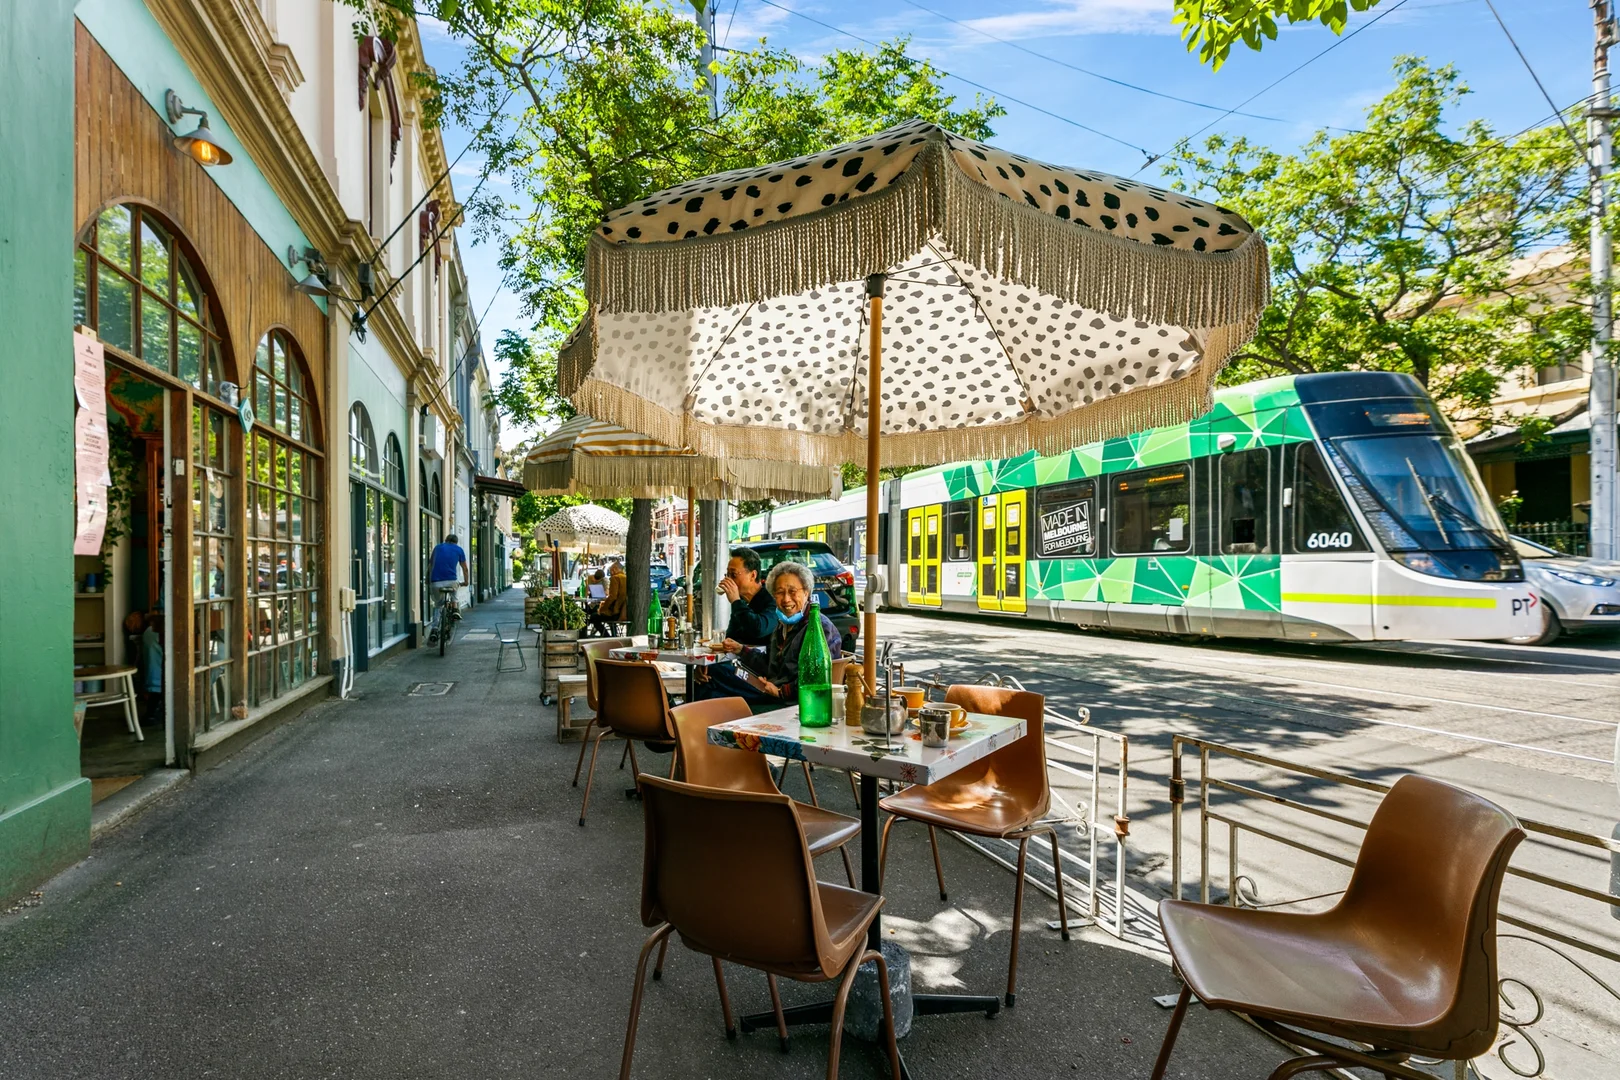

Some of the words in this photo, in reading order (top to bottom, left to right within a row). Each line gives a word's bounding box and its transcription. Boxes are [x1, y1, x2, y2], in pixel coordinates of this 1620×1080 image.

[1043, 509, 1074, 531] MADE
[1075, 505, 1087, 521] IN
[1044, 521, 1088, 540] MELBOURNE
[1045, 542, 1056, 551] FOR
[1056, 533, 1089, 549] MELBOURNE
[1307, 532, 1352, 548] 6040
